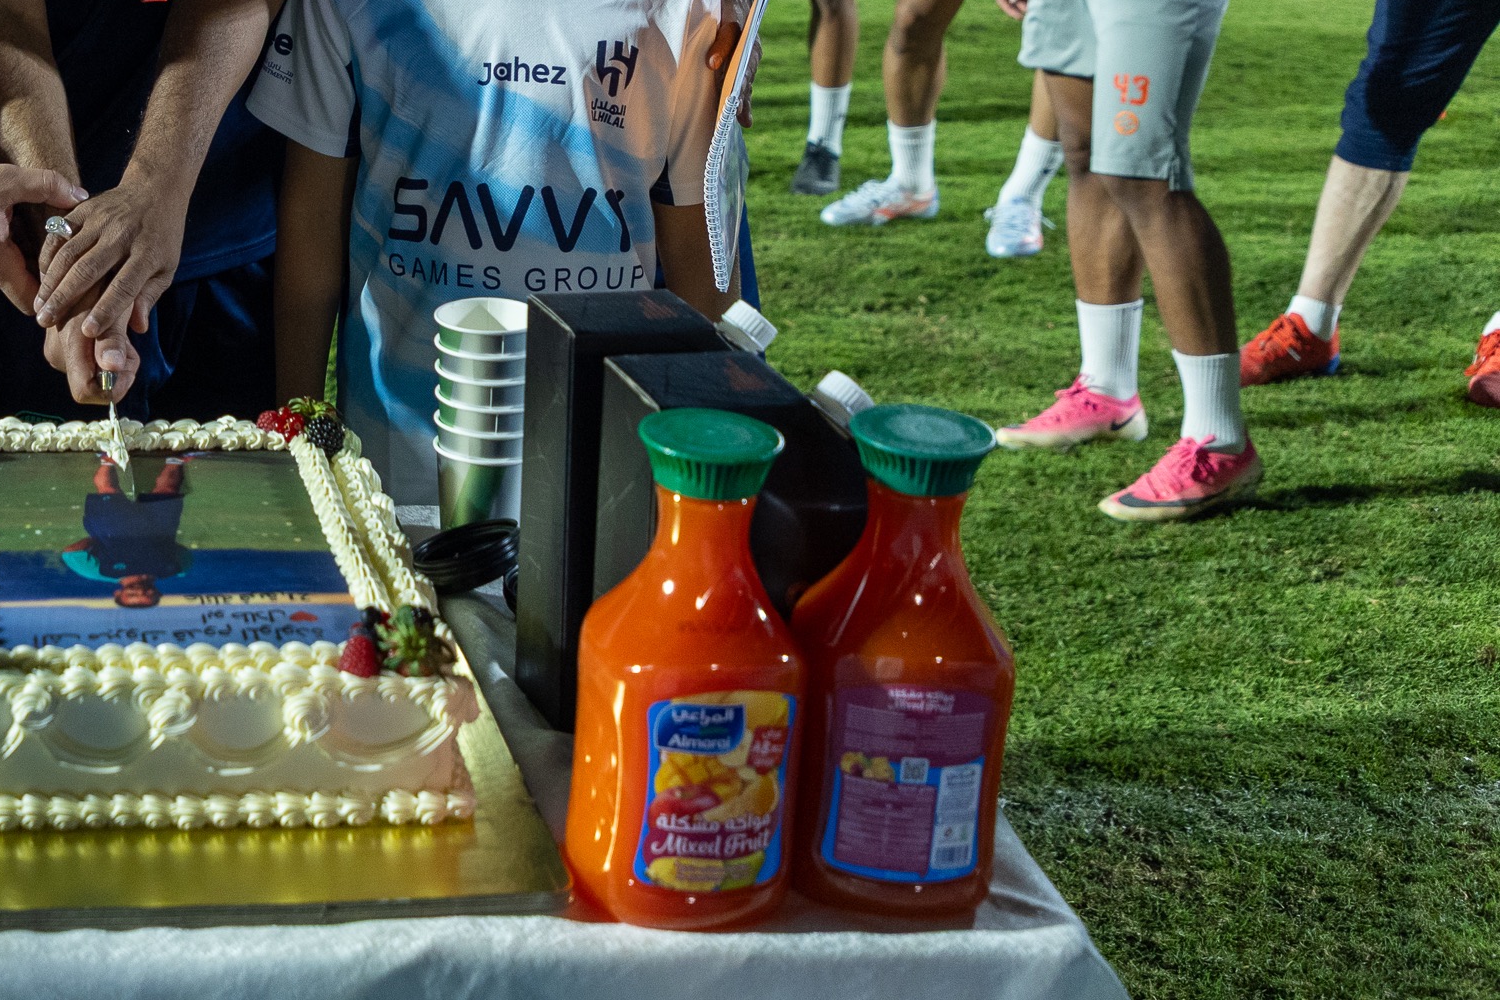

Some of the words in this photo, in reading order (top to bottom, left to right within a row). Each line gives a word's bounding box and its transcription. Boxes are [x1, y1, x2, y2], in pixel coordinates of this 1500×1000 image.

[477, 56, 567, 86] jahez
[1112, 72, 1151, 107] 43
[591, 98, 627, 116] الهلال
[388, 176, 631, 253] SAVVY
[388, 253, 501, 290] GAMES
[524, 264, 645, 292] GROUP
[670, 707, 735, 727] المراعي
[668, 733, 731, 750] Almarai
[651, 833, 721, 857] Mixed
[724, 830, 770, 857] Fruit
